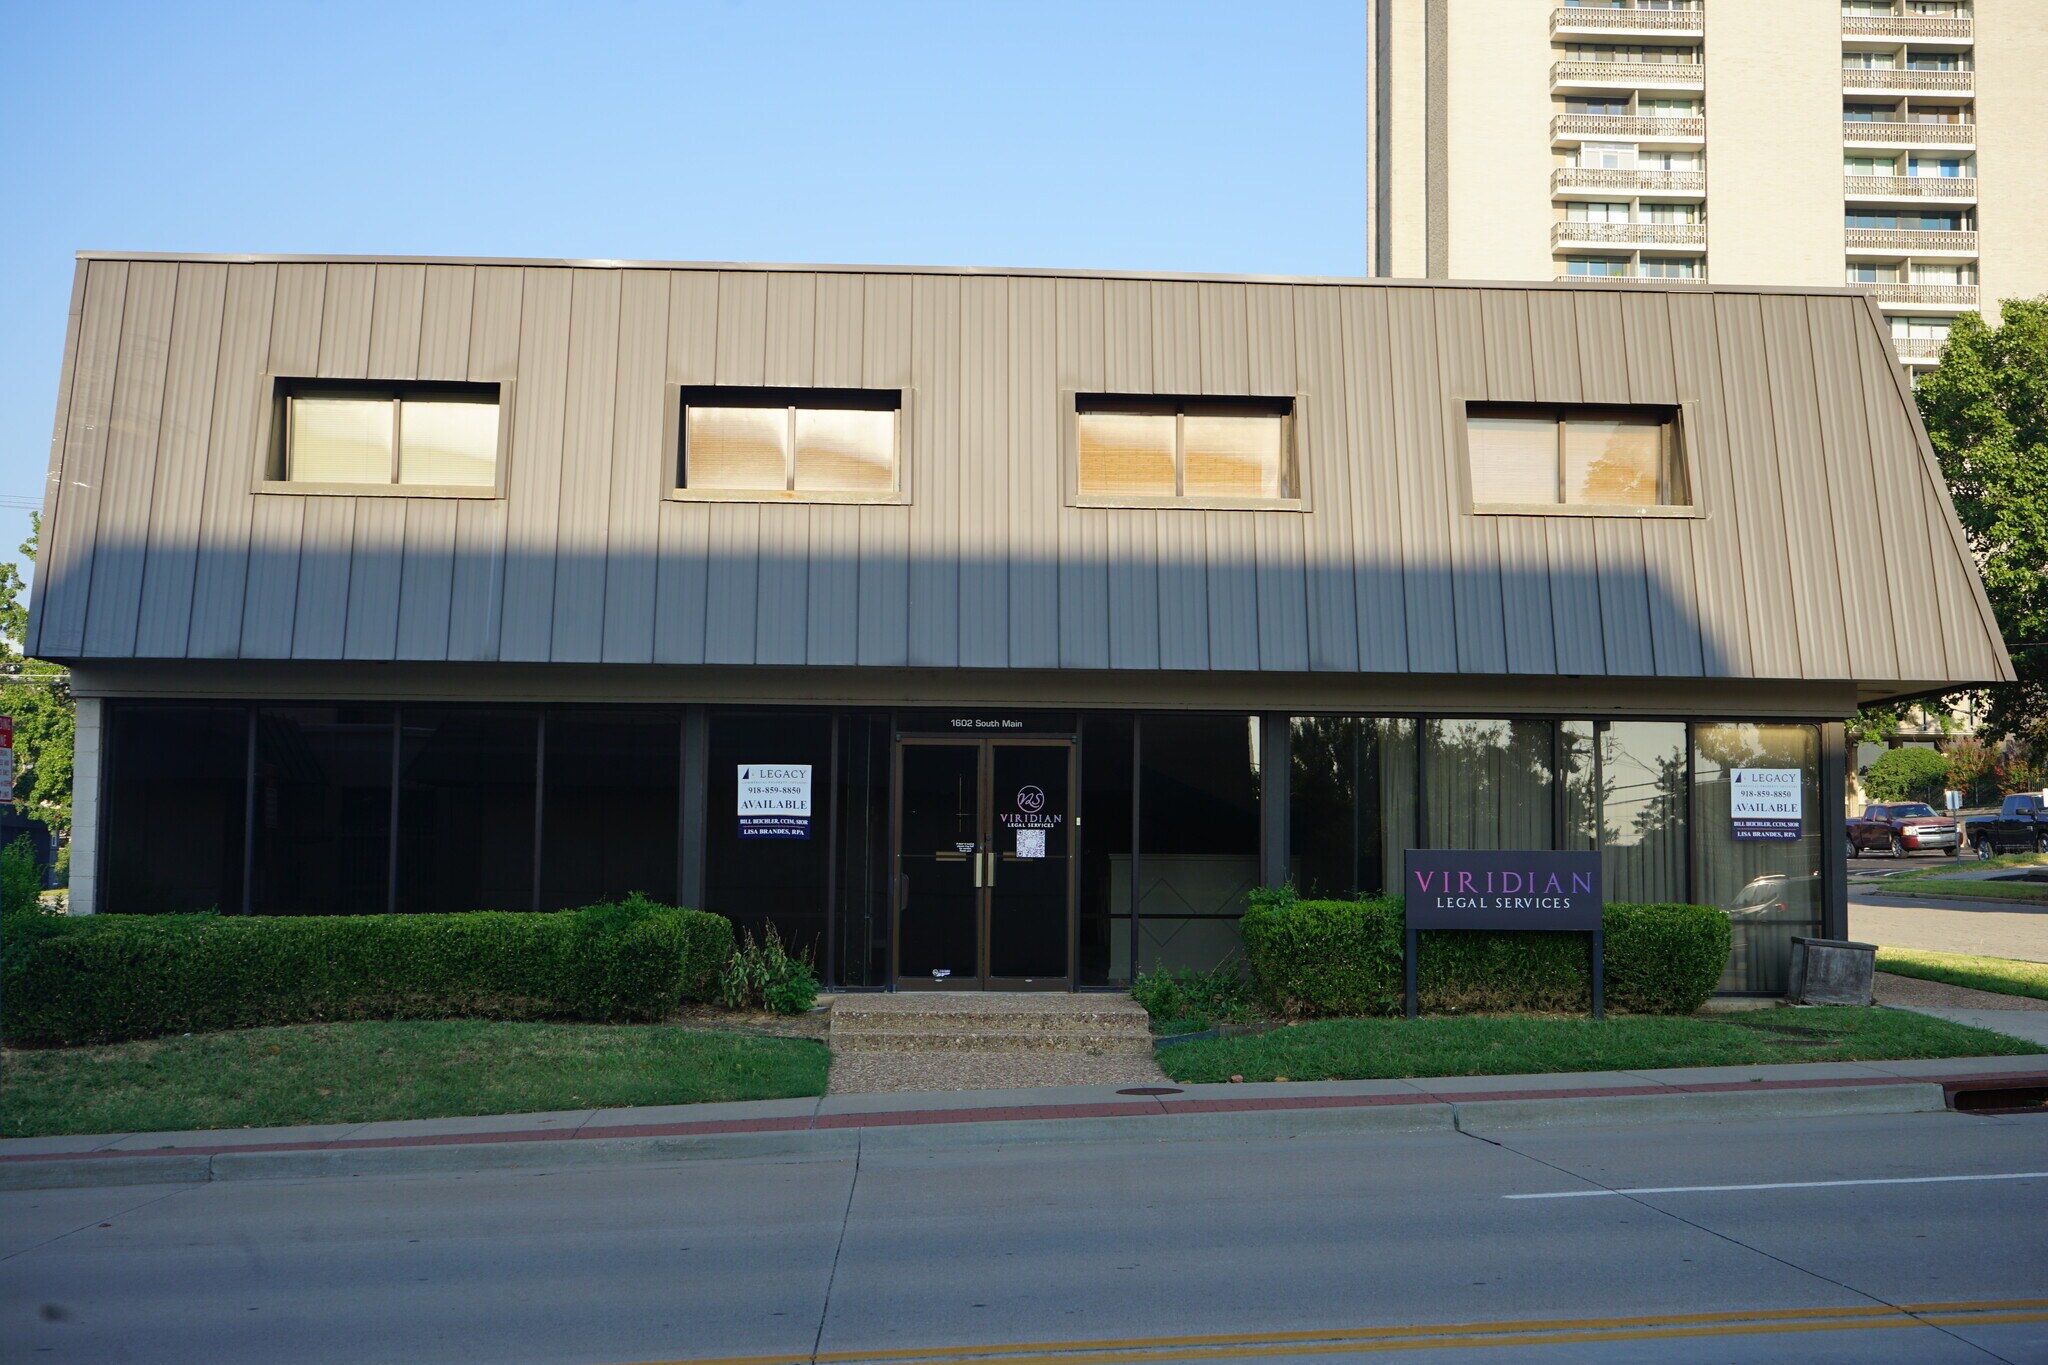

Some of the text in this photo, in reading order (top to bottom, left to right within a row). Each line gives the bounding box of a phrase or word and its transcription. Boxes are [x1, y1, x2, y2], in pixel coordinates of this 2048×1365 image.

[950, 719, 1023, 728] 1602 South Main
[760, 769, 807, 779] LEGACY
[1751, 773, 1796, 783] LEGACY
[748, 786, 801, 794] 918-859-8850
[1740, 790, 1792, 798] 918-859-8850
[741, 799, 808, 810] AVAILABLE
[1734, 802, 1798, 813] AVAILABLE
[999, 813, 1062, 823] VIRIDIAN
[759, 828, 791, 836] BRANDES,
[1414, 871, 1593, 894] VIRIDIAN
[1436, 897, 1571, 909] LEGAL SERVICES
